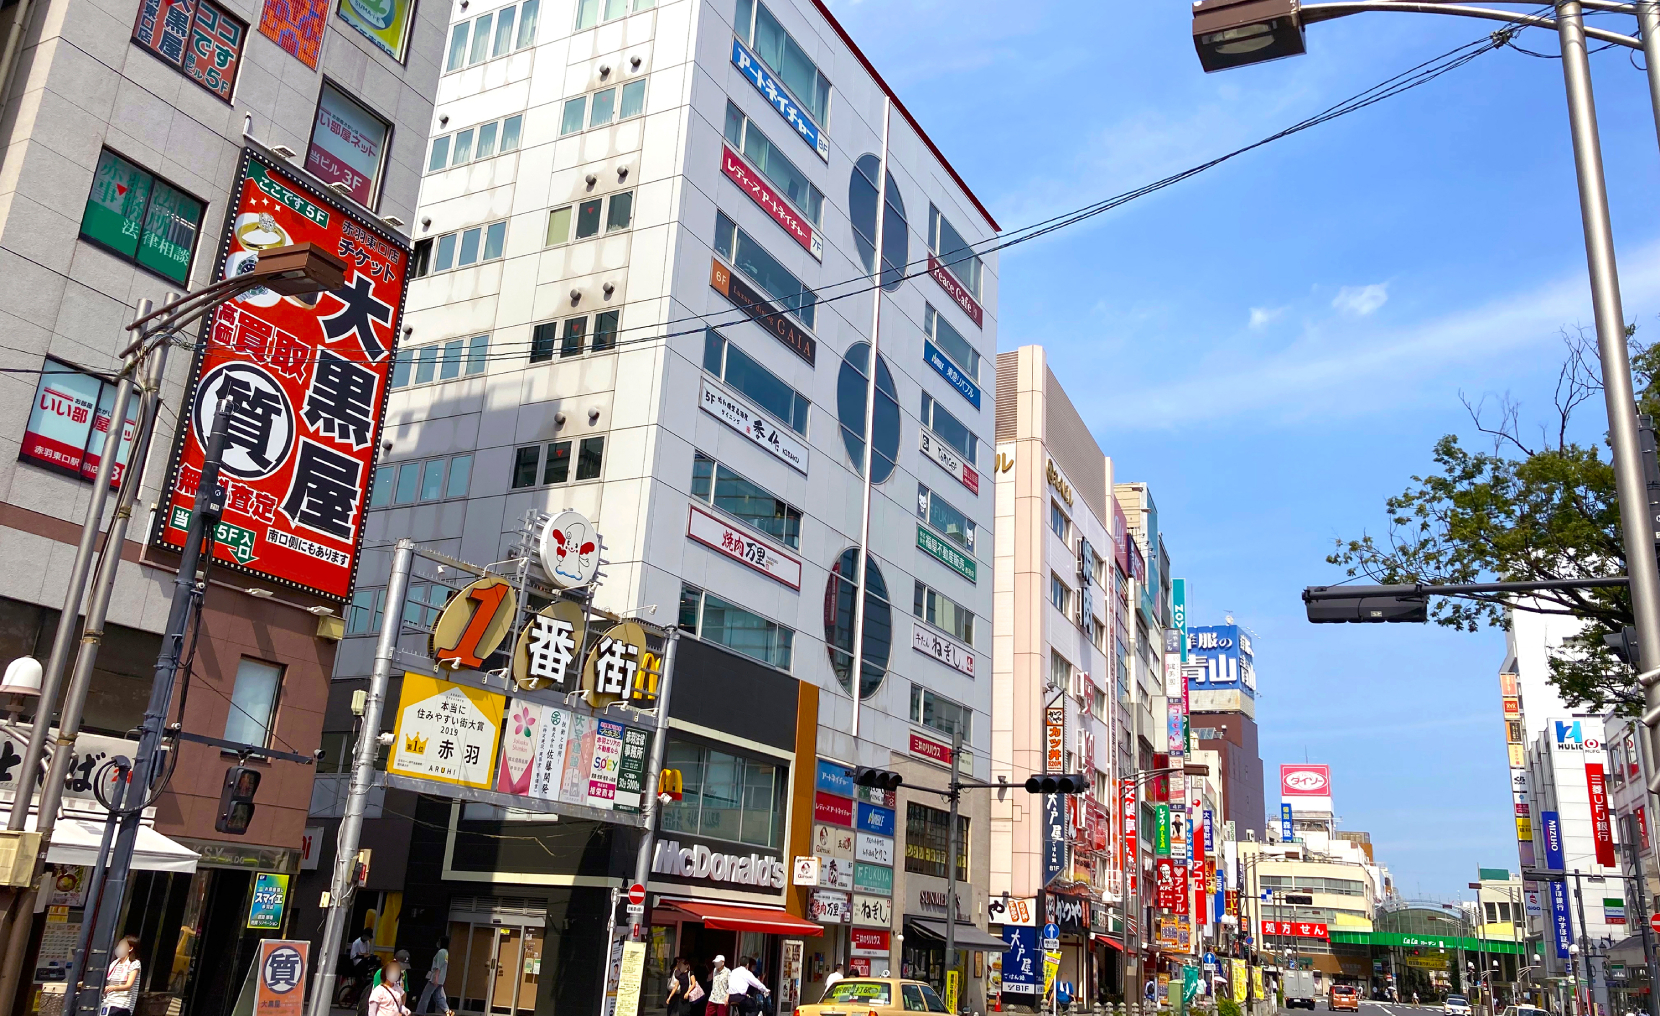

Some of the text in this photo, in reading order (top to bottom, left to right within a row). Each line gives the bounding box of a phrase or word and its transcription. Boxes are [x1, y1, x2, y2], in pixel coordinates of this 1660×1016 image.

[157, 0, 192, 64] 黒屋
[205, 66, 229, 94] 5F
[738, 47, 815, 139] アートネイチャー
[309, 149, 362, 189] 当ビル 3F
[258, 175, 327, 223] ここです 5F
[727, 157, 761, 197] レディース
[761, 189, 808, 238] アートネイチャー
[121, 218, 190, 266] 法律相談
[341, 218, 400, 264] 赤羽東口店
[337, 236, 396, 284] チケット
[715, 270, 727, 286] 6F
[230, 308, 312, 384] 買取
[208, 370, 284, 472] 質
[280, 268, 394, 542] 大黒屋
[174, 461, 279, 525] 無査定
[266, 530, 351, 567] 南口側にもあります
[722, 529, 745, 558] 焼肉
[745, 541, 766, 568] 万里
[931, 636, 961, 668] ねぎし
[1182, 652, 1238, 683] 青山
[417, 708, 486, 732] 住みやすい街大賞
[440, 700, 467, 715] 本当に
[440, 725, 459, 737] 2019
[1048, 726, 1062, 761] カツ丼
[438, 739, 481, 766] 赤羽
[593, 756, 618, 772] SOEY
[597, 745, 619, 754] 不動産なら
[914, 739, 941, 758] 三井のリハウス
[428, 764, 457, 776] ARUHI
[541, 749, 556, 794] 佐藤開発
[1590, 774, 1610, 843] 三菱UFJ銀行
[1547, 819, 1559, 852] MIZUHO
[651, 838, 786, 890] McDonald's
[863, 865, 890, 883] FUKUYA
[1193, 860, 1204, 891] アコム
[255, 892, 284, 905] スマイエ
[827, 901, 840, 917] 万里
[860, 898, 888, 924] ねぎし
[1174, 876, 1186, 913] アイフル
[855, 933, 881, 945] 三井のリハウス
[1264, 921, 1325, 937] 処方せん
[1011, 929, 1034, 977] 大戸屋
